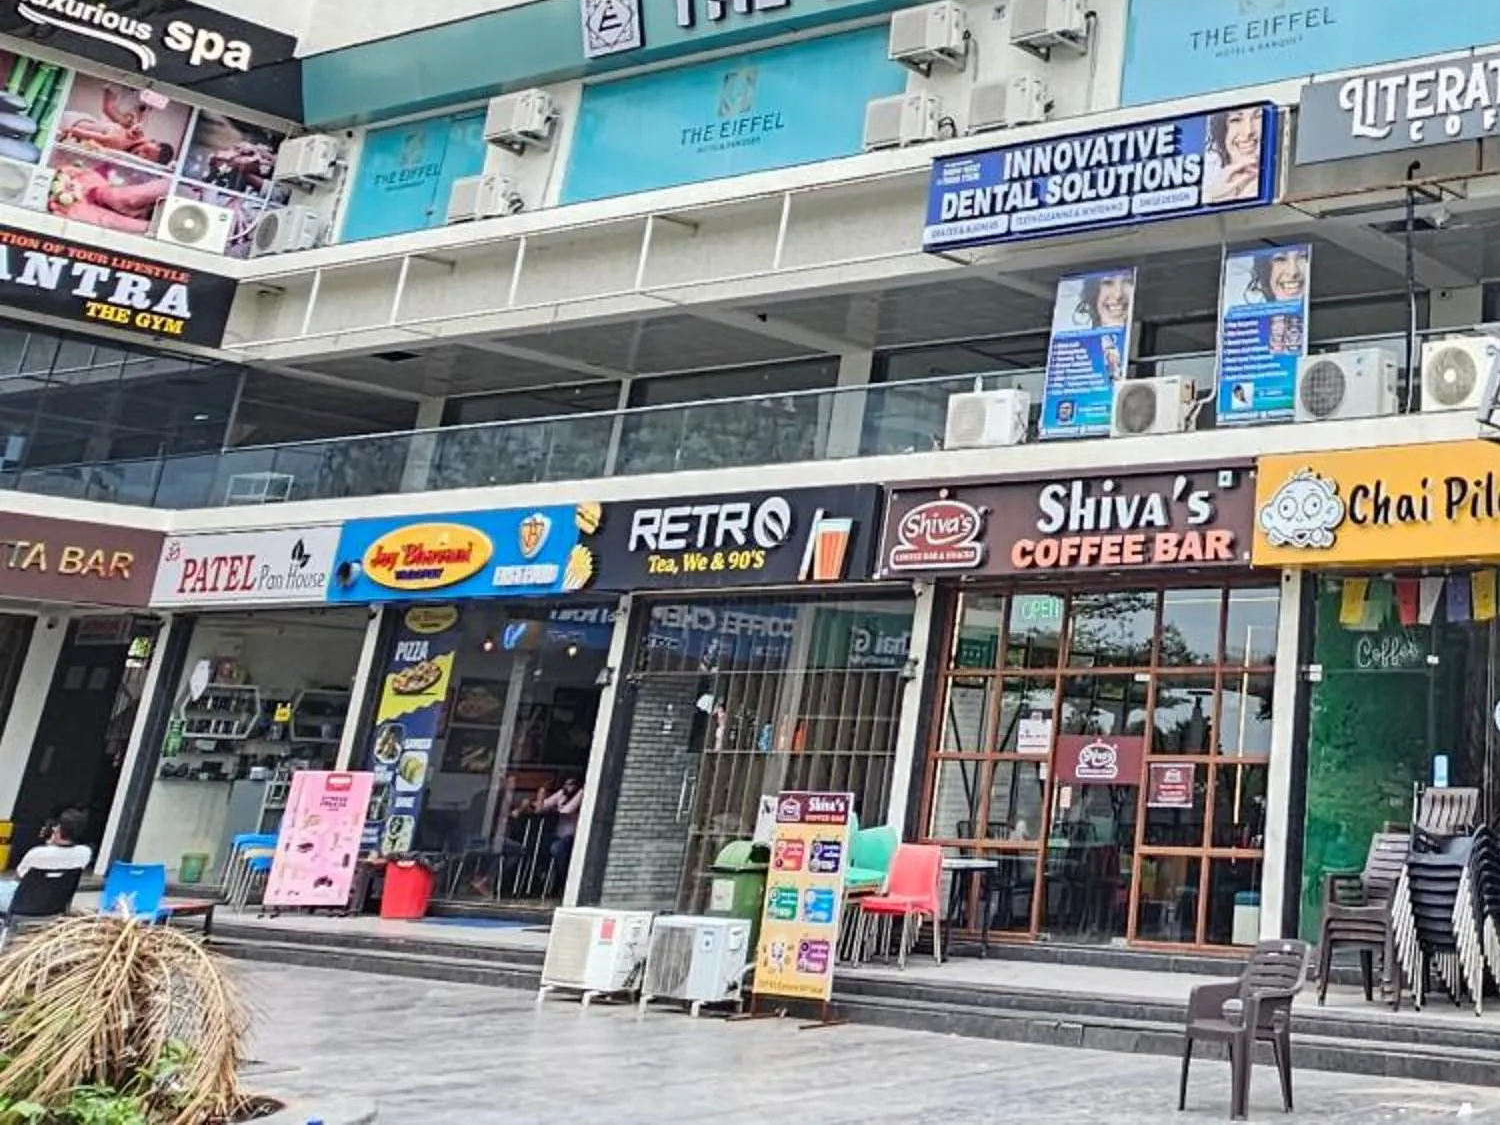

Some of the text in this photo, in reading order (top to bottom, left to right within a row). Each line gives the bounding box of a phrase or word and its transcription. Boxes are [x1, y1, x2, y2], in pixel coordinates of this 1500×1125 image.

[163, 20, 252, 72] spa
[1189, 6, 1337, 51] THE EIFFEL
[681, 124, 716, 147] THE
[720, 111, 785, 138] EIFFEL
[1003, 125, 1181, 181] INNOVATIVE
[940, 153, 1202, 221] DENTAL SOLUTIONS
[67, 247, 110, 264] YOUR
[112, 257, 192, 284] LIFESTYLE
[86, 301, 185, 335] THE GYM
[1348, 477, 1432, 526] Chai
[628, 496, 792, 552] RETRO
[904, 511, 974, 546] Shiva's
[59, 546, 135, 580] BAR
[648, 554, 678, 575] Tea,
[683, 553, 708, 573] We
[710, 553, 725, 571] &
[1011, 529, 1234, 570] COFFEE BAR
[177, 554, 326, 594] PATEL Pan House
[1020, 598, 1060, 621] OPEN
[395, 640, 430, 662] PIZZA
